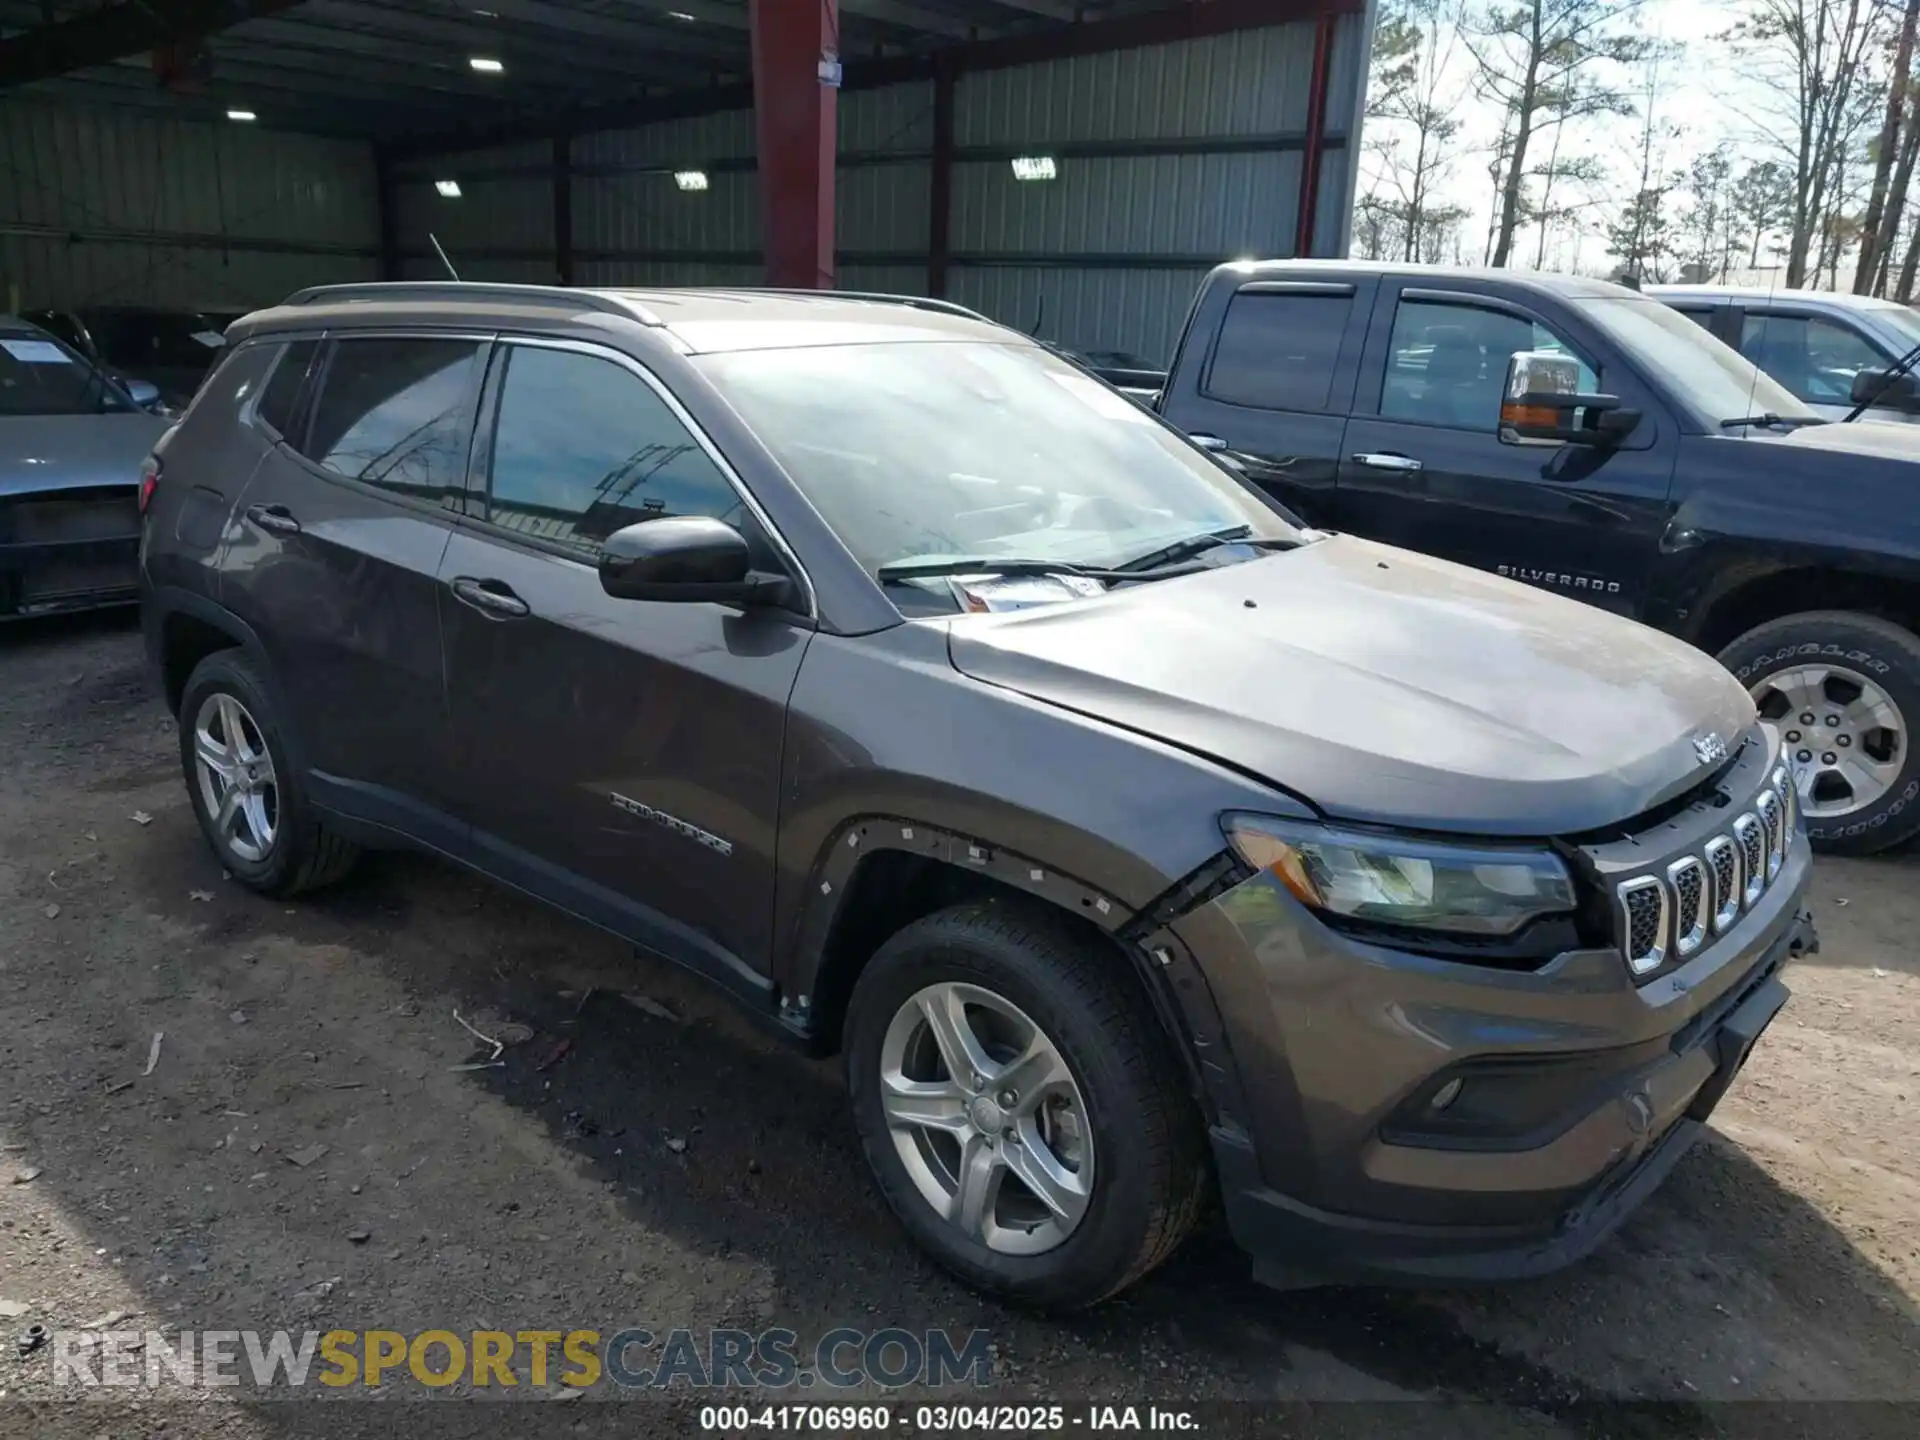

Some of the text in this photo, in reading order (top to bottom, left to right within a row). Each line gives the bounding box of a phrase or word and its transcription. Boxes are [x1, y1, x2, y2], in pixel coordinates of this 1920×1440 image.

[1497, 564, 1621, 593] SILVERADO
[1736, 642, 1891, 682] RANGLER
[609, 791, 733, 857] COMPASS
